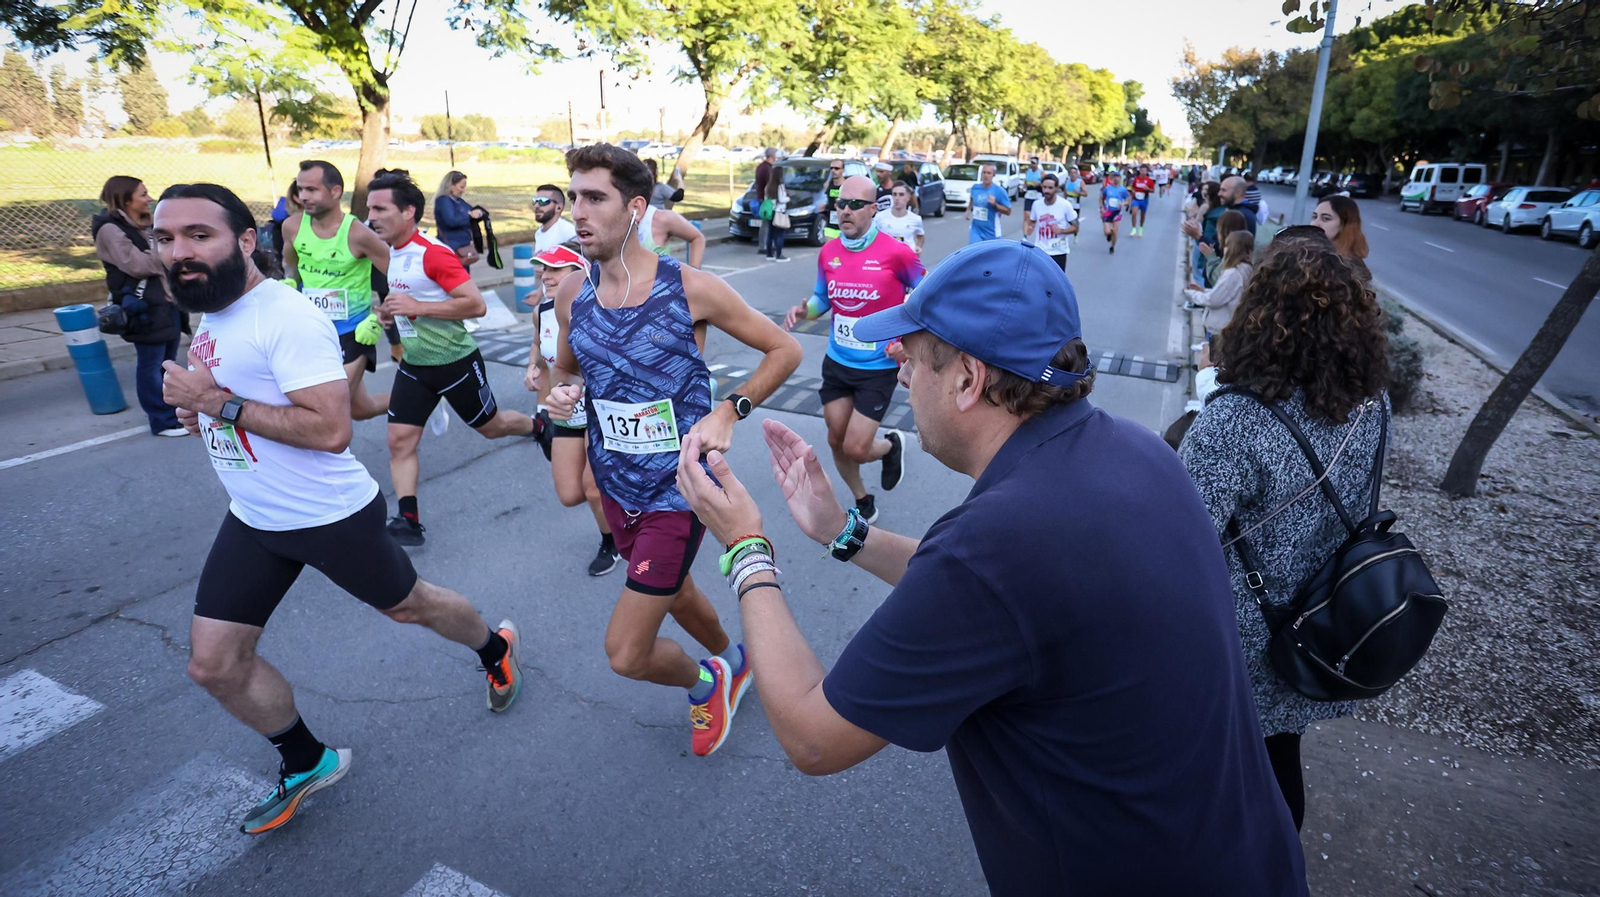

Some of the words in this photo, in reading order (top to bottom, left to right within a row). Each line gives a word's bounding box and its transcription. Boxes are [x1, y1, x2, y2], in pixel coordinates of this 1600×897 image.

[827, 280, 880, 300] Cuevas
[309, 296, 328, 308] 60
[837, 323, 854, 337] 43
[607, 414, 641, 437] 137
